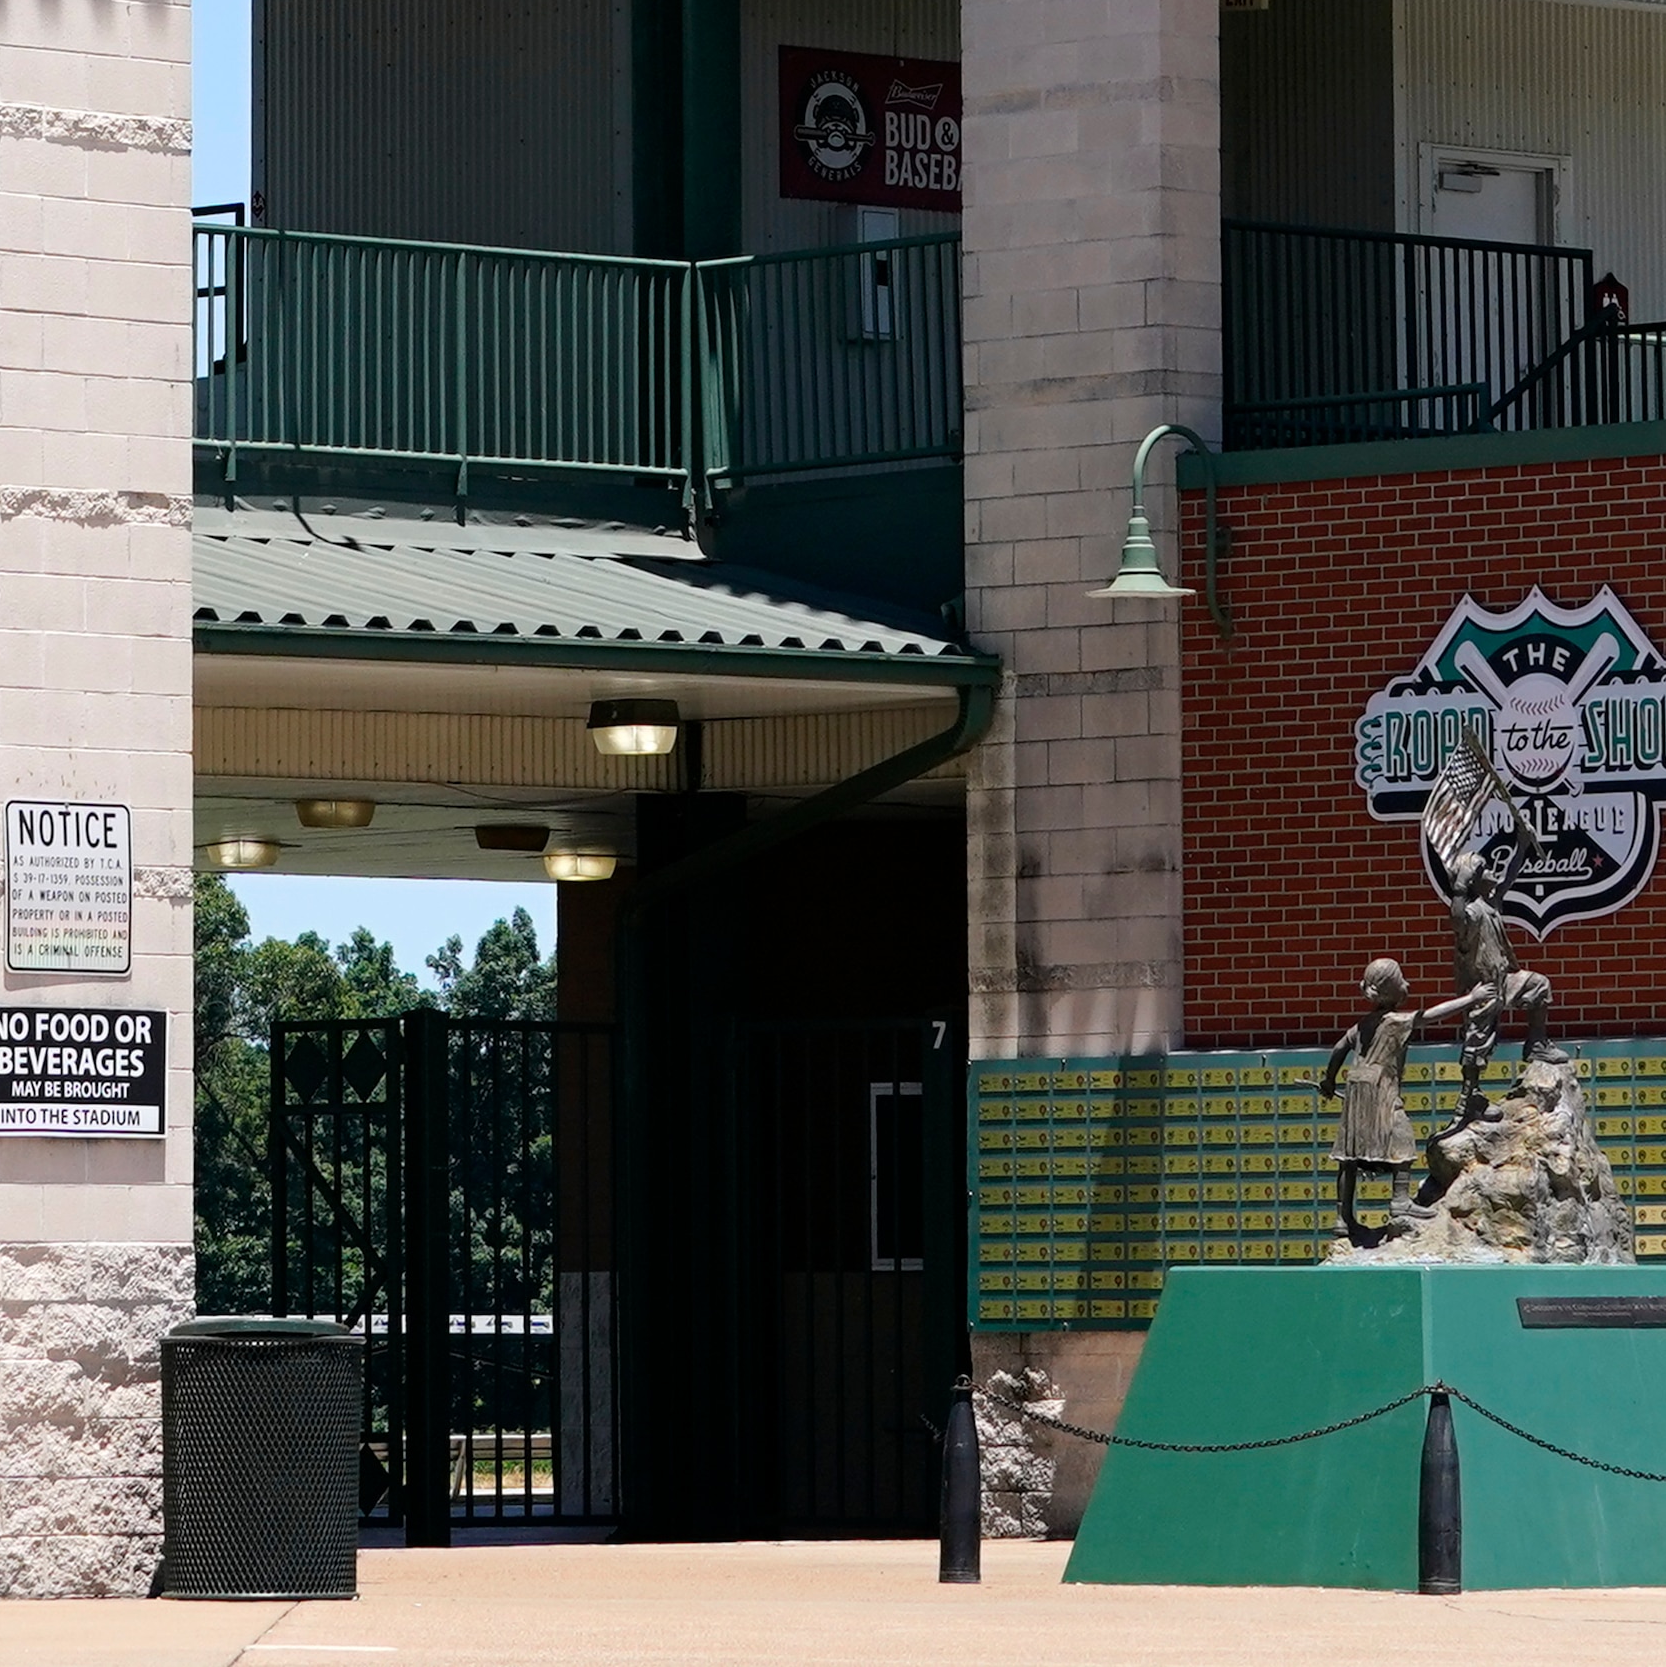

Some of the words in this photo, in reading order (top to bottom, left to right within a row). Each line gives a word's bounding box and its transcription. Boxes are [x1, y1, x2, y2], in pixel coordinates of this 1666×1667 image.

[810, 69, 859, 92] JACKSON
[885, 111, 931, 150] BUD
[807, 155, 862, 181] GENERALS
[885, 149, 962, 192] BASEB
[1502, 642, 1572, 672] THE
[19, 809, 117, 848] NOTICE
[1533, 800, 1625, 842] LEAGUE
[13, 855, 24, 867] AS
[29, 856, 80, 869] AUTHORIZED
[84, 857, 95, 869] BY
[1491, 845, 1592, 883] Bseball
[75, 874, 124, 887] POSSESSION
[12, 889, 23, 901] OF
[28, 890, 33, 901] A
[40, 890, 74, 902] WEAPON
[78, 891, 91, 903] ON
[94, 891, 128, 904] POSTED
[12, 908, 54, 920] PROPERTY
[59, 909, 70, 921] OR
[74, 910, 82, 921] IN
[87, 911, 93, 921] A
[97, 911, 129, 924] POSTED
[12, 926, 48, 938] BUILDING
[51, 928, 60, 939] IS
[63, 928, 108, 940] PROHIBITED
[112, 929, 128, 941] AND
[14, 943, 23, 955] IS
[27, 944, 33, 955] A
[38, 944, 79, 956] CRIMINAL
[84, 945, 123, 958] OFFENSE
[35, 1013, 110, 1042] FOOD
[114, 1015, 152, 1044] OR
[932, 1021, 947, 1049] 7
[11, 1080, 42, 1097] MAY
[44, 1081, 62, 1097] BE
[63, 1081, 130, 1098] BROUGHT
[1, 1108, 37, 1125] INTO
[40, 1108, 69, 1125] THE
[72, 1109, 141, 1126] STADIUM
